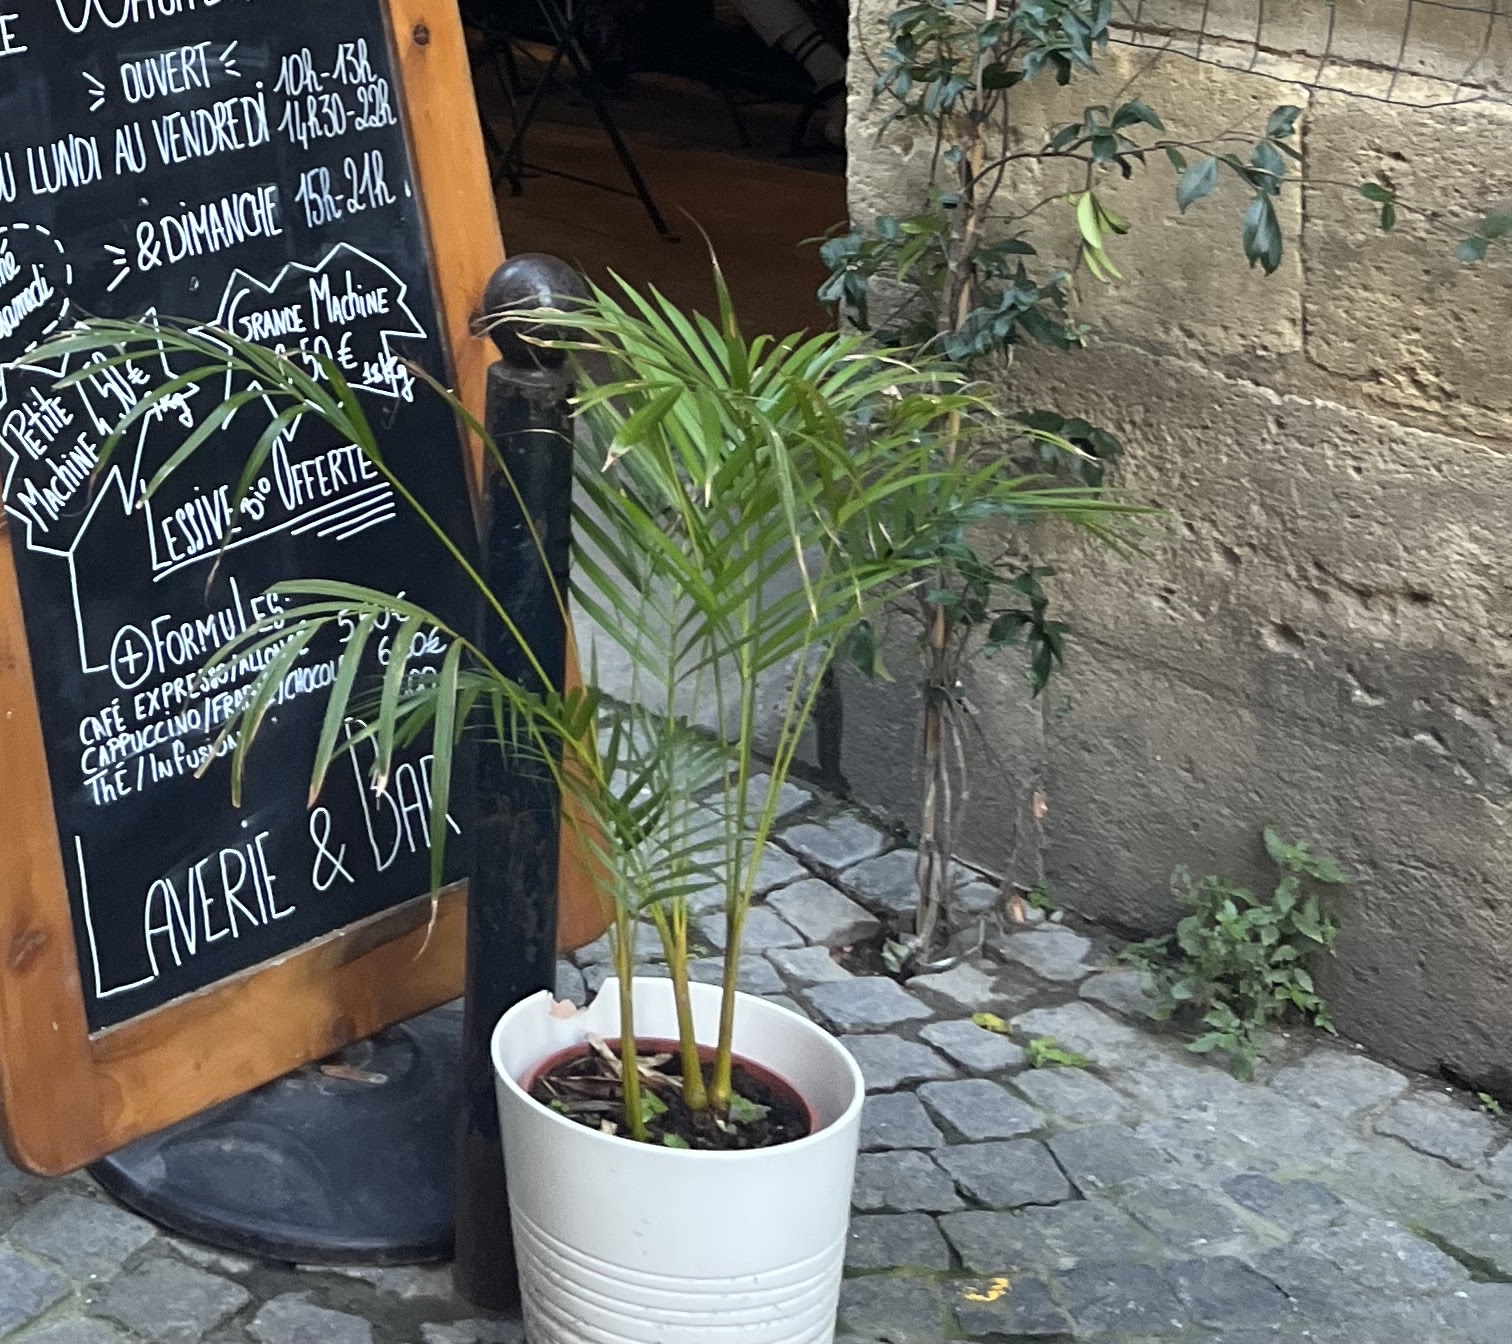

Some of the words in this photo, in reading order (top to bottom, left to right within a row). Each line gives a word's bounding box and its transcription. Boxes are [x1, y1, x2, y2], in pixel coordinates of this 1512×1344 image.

[120, 41, 213, 104] OUVERT
[115, 119, 148, 175] AU
[309, 807, 356, 892] &
